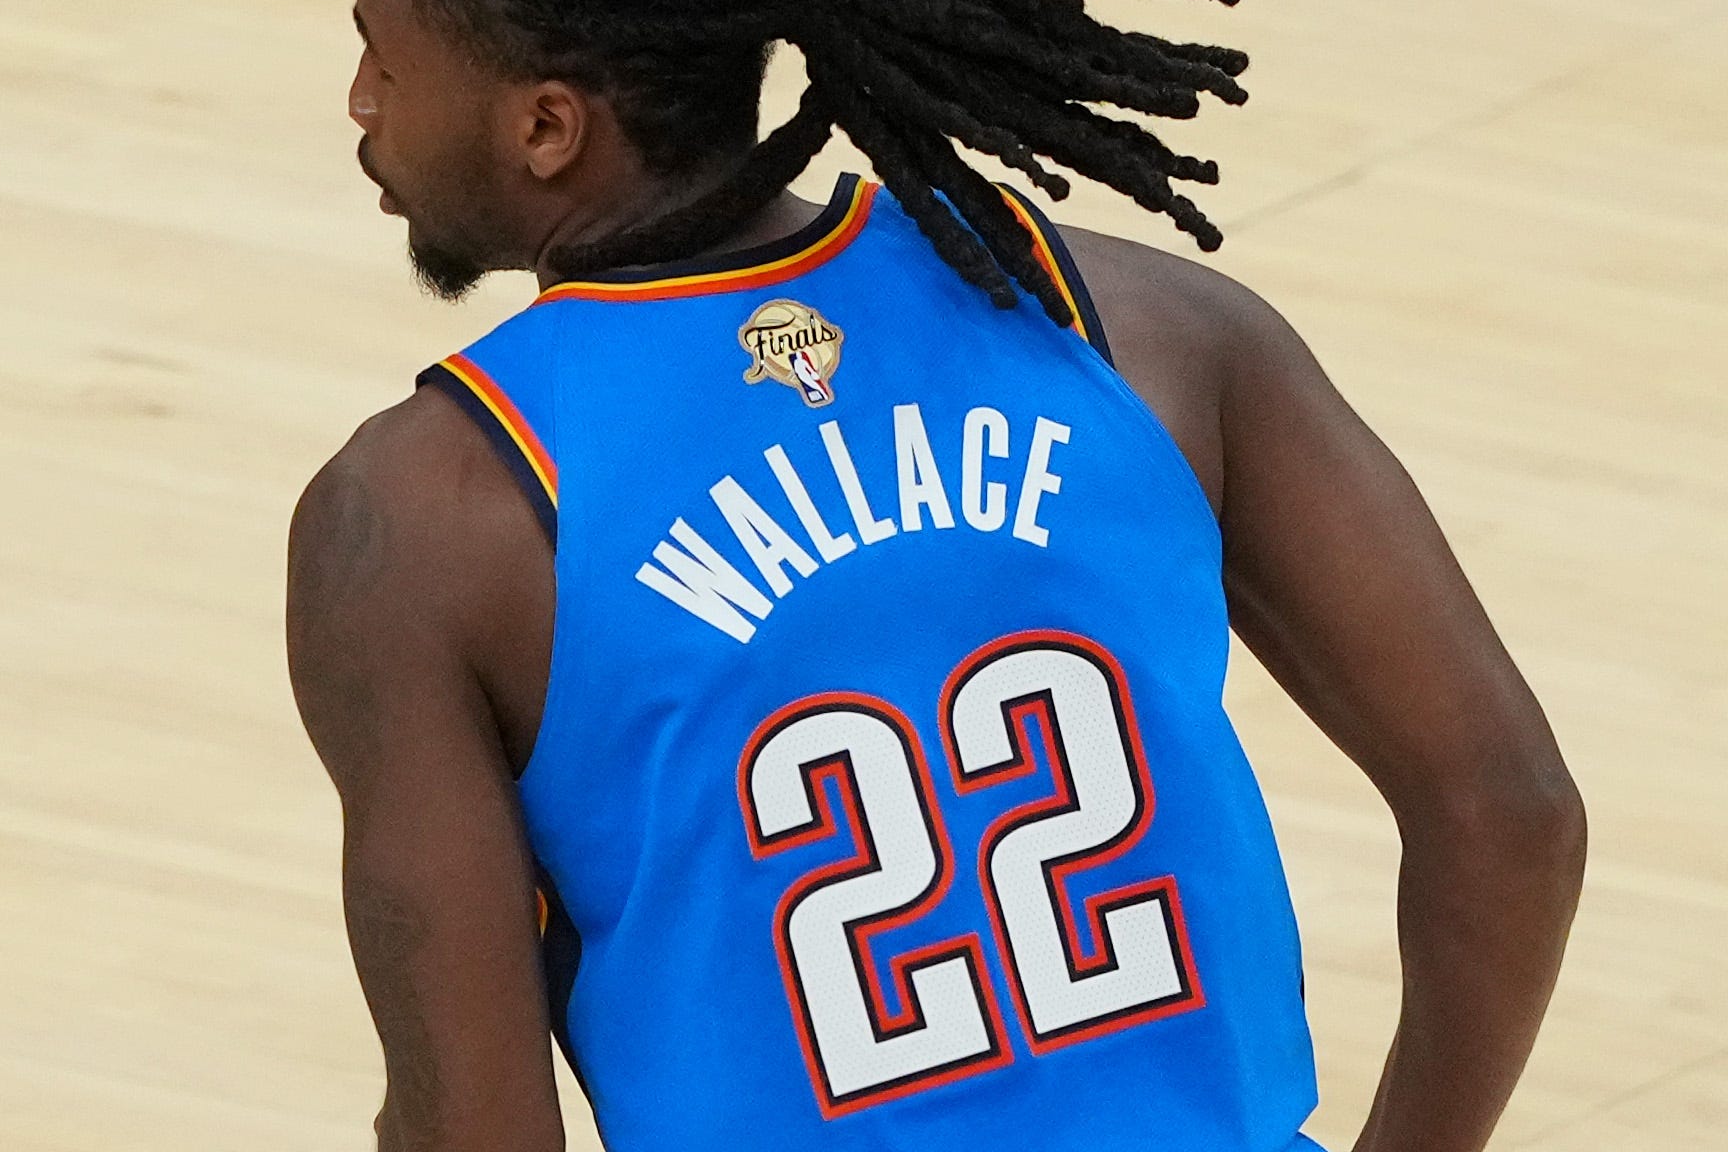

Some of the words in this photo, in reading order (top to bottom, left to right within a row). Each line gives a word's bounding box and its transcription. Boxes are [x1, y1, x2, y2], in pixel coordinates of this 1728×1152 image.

[744, 313, 837, 378] Finals
[635, 403, 1071, 645] WALLACE
[736, 628, 1206, 1121] 22
